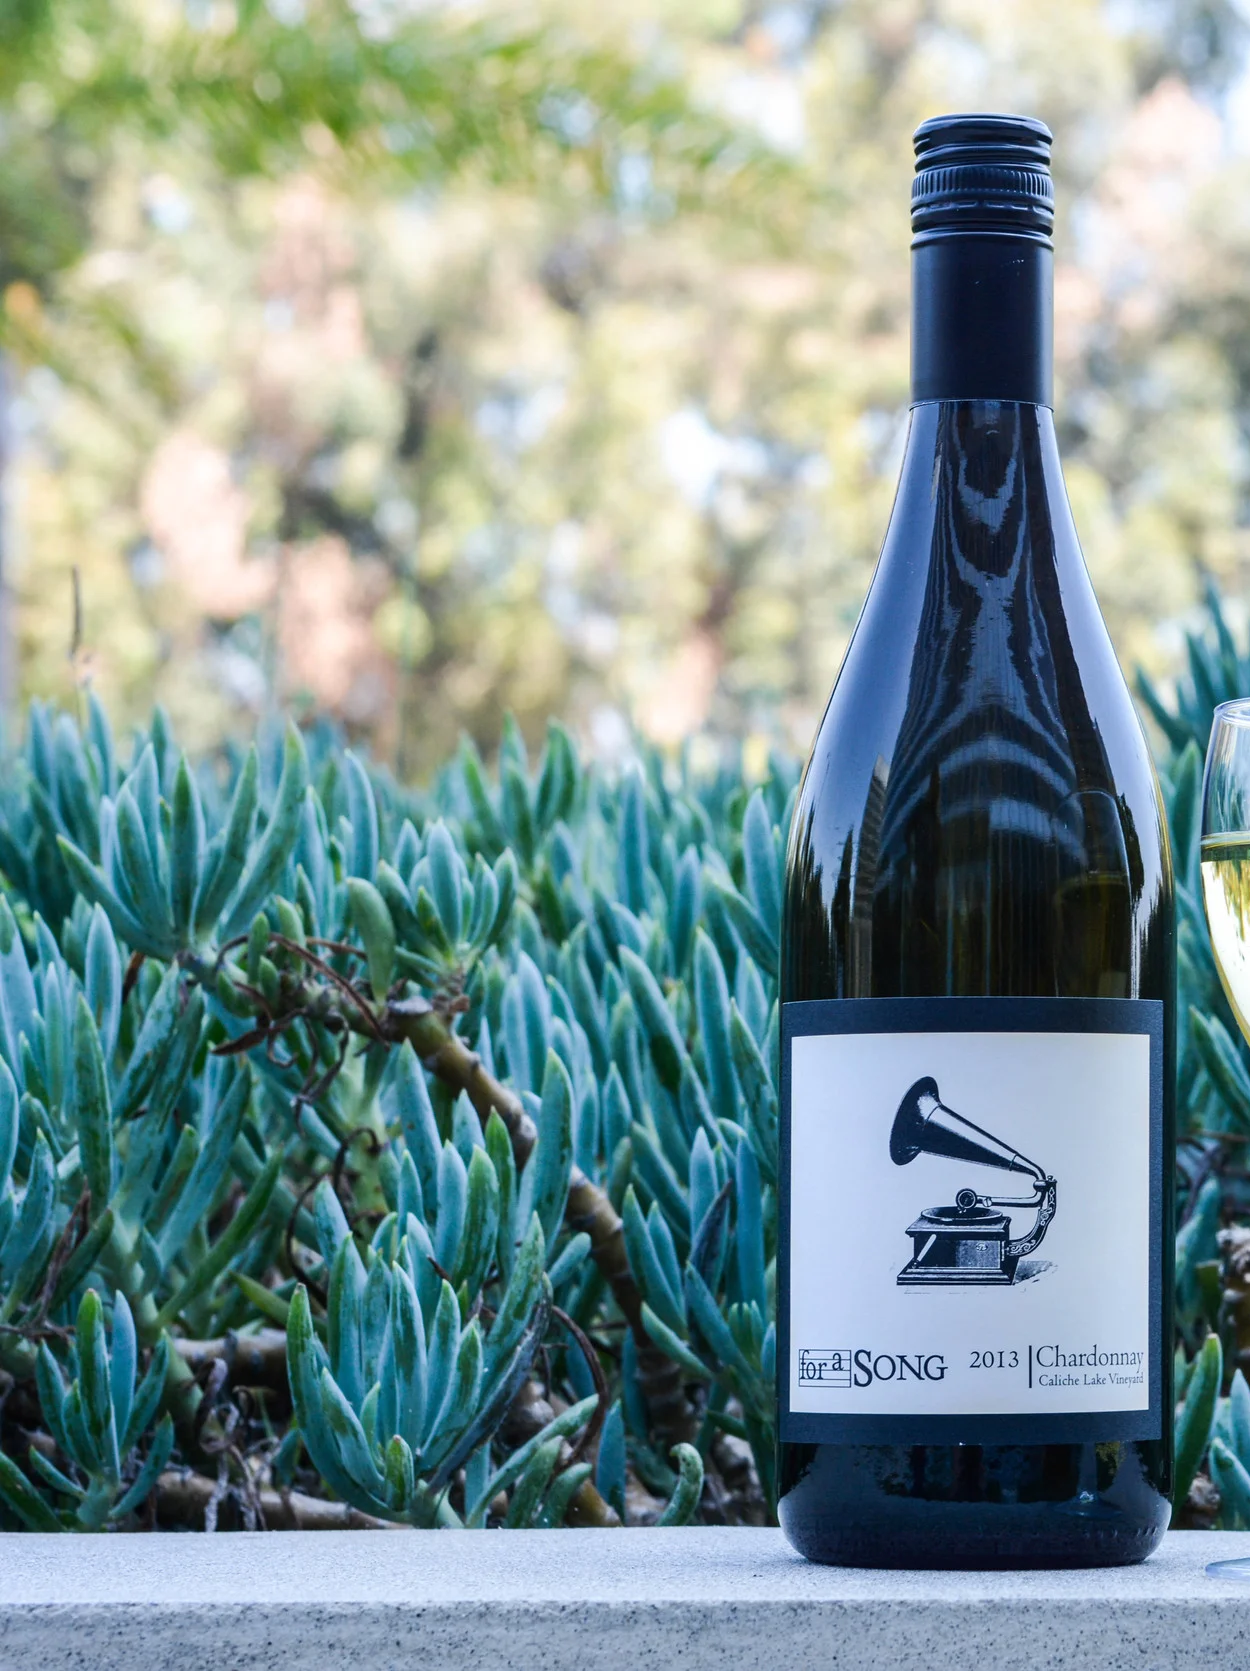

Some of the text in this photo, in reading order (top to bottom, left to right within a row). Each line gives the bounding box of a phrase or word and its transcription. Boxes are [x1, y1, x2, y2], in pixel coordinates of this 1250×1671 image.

[800, 1349, 949, 1388] for a SONG
[969, 1350, 1020, 1369] 2013
[1036, 1344, 1145, 1374] Chardonnay
[1038, 1372, 1145, 1388] Caliche Lake Vineyard
